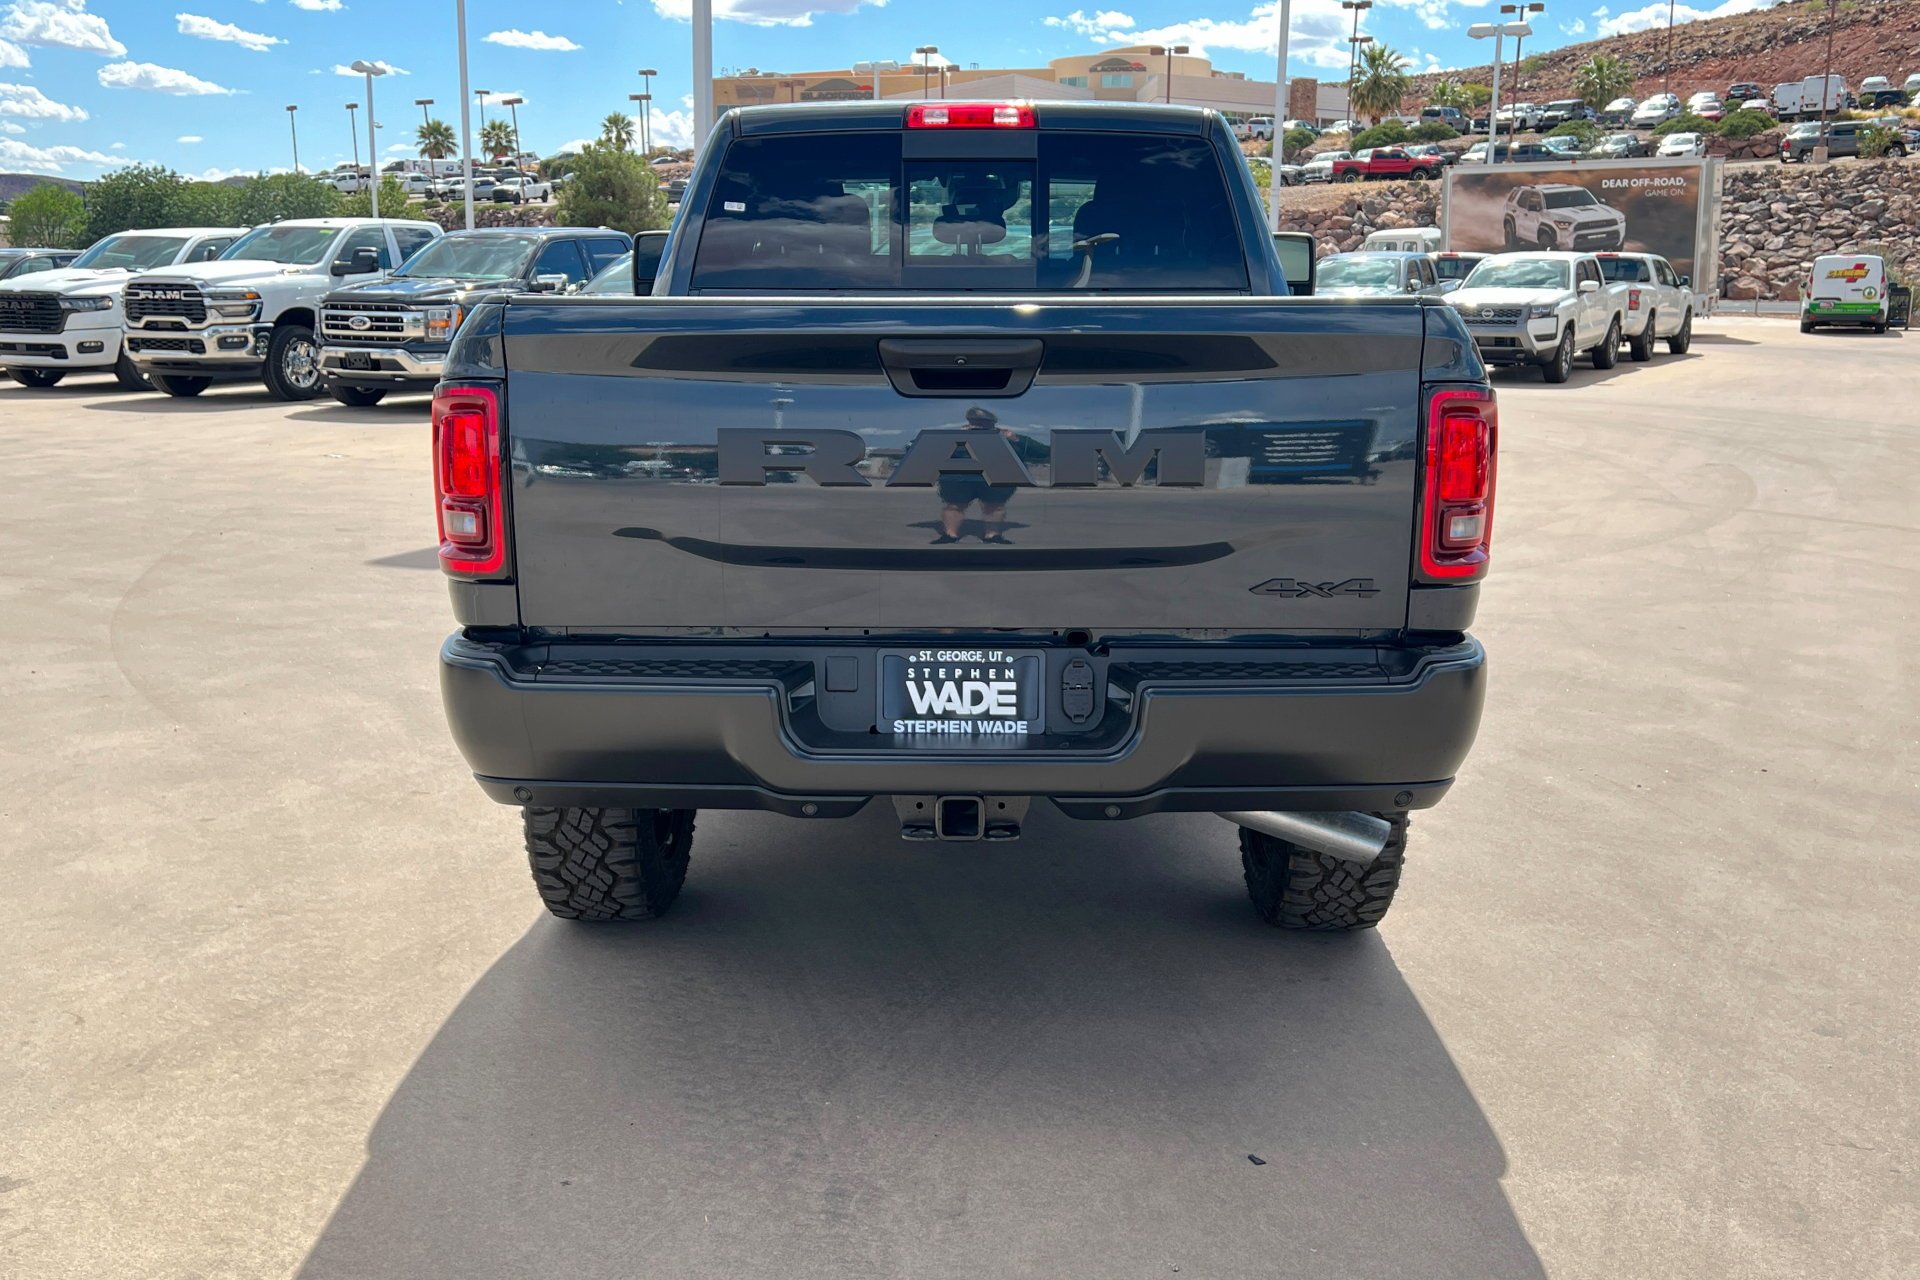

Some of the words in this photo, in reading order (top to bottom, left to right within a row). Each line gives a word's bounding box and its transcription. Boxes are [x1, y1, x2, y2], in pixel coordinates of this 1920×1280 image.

[1602, 179, 1629, 189] DEAR
[1630, 177, 1687, 188] OFF-ROAD,
[1644, 189, 1669, 197] GAME
[140, 289, 180, 300] RAM
[717, 427, 1208, 488] RAM
[1249, 578, 1381, 599] 4x4
[919, 650, 934, 662] ST.
[937, 650, 986, 663] GEORGE,
[988, 651, 1003, 662] UT
[907, 668, 1015, 679] STEPHEN
[905, 680, 1017, 715] WADE
[893, 720, 973, 734] STEPHEN
[977, 720, 1028, 734] WADE
